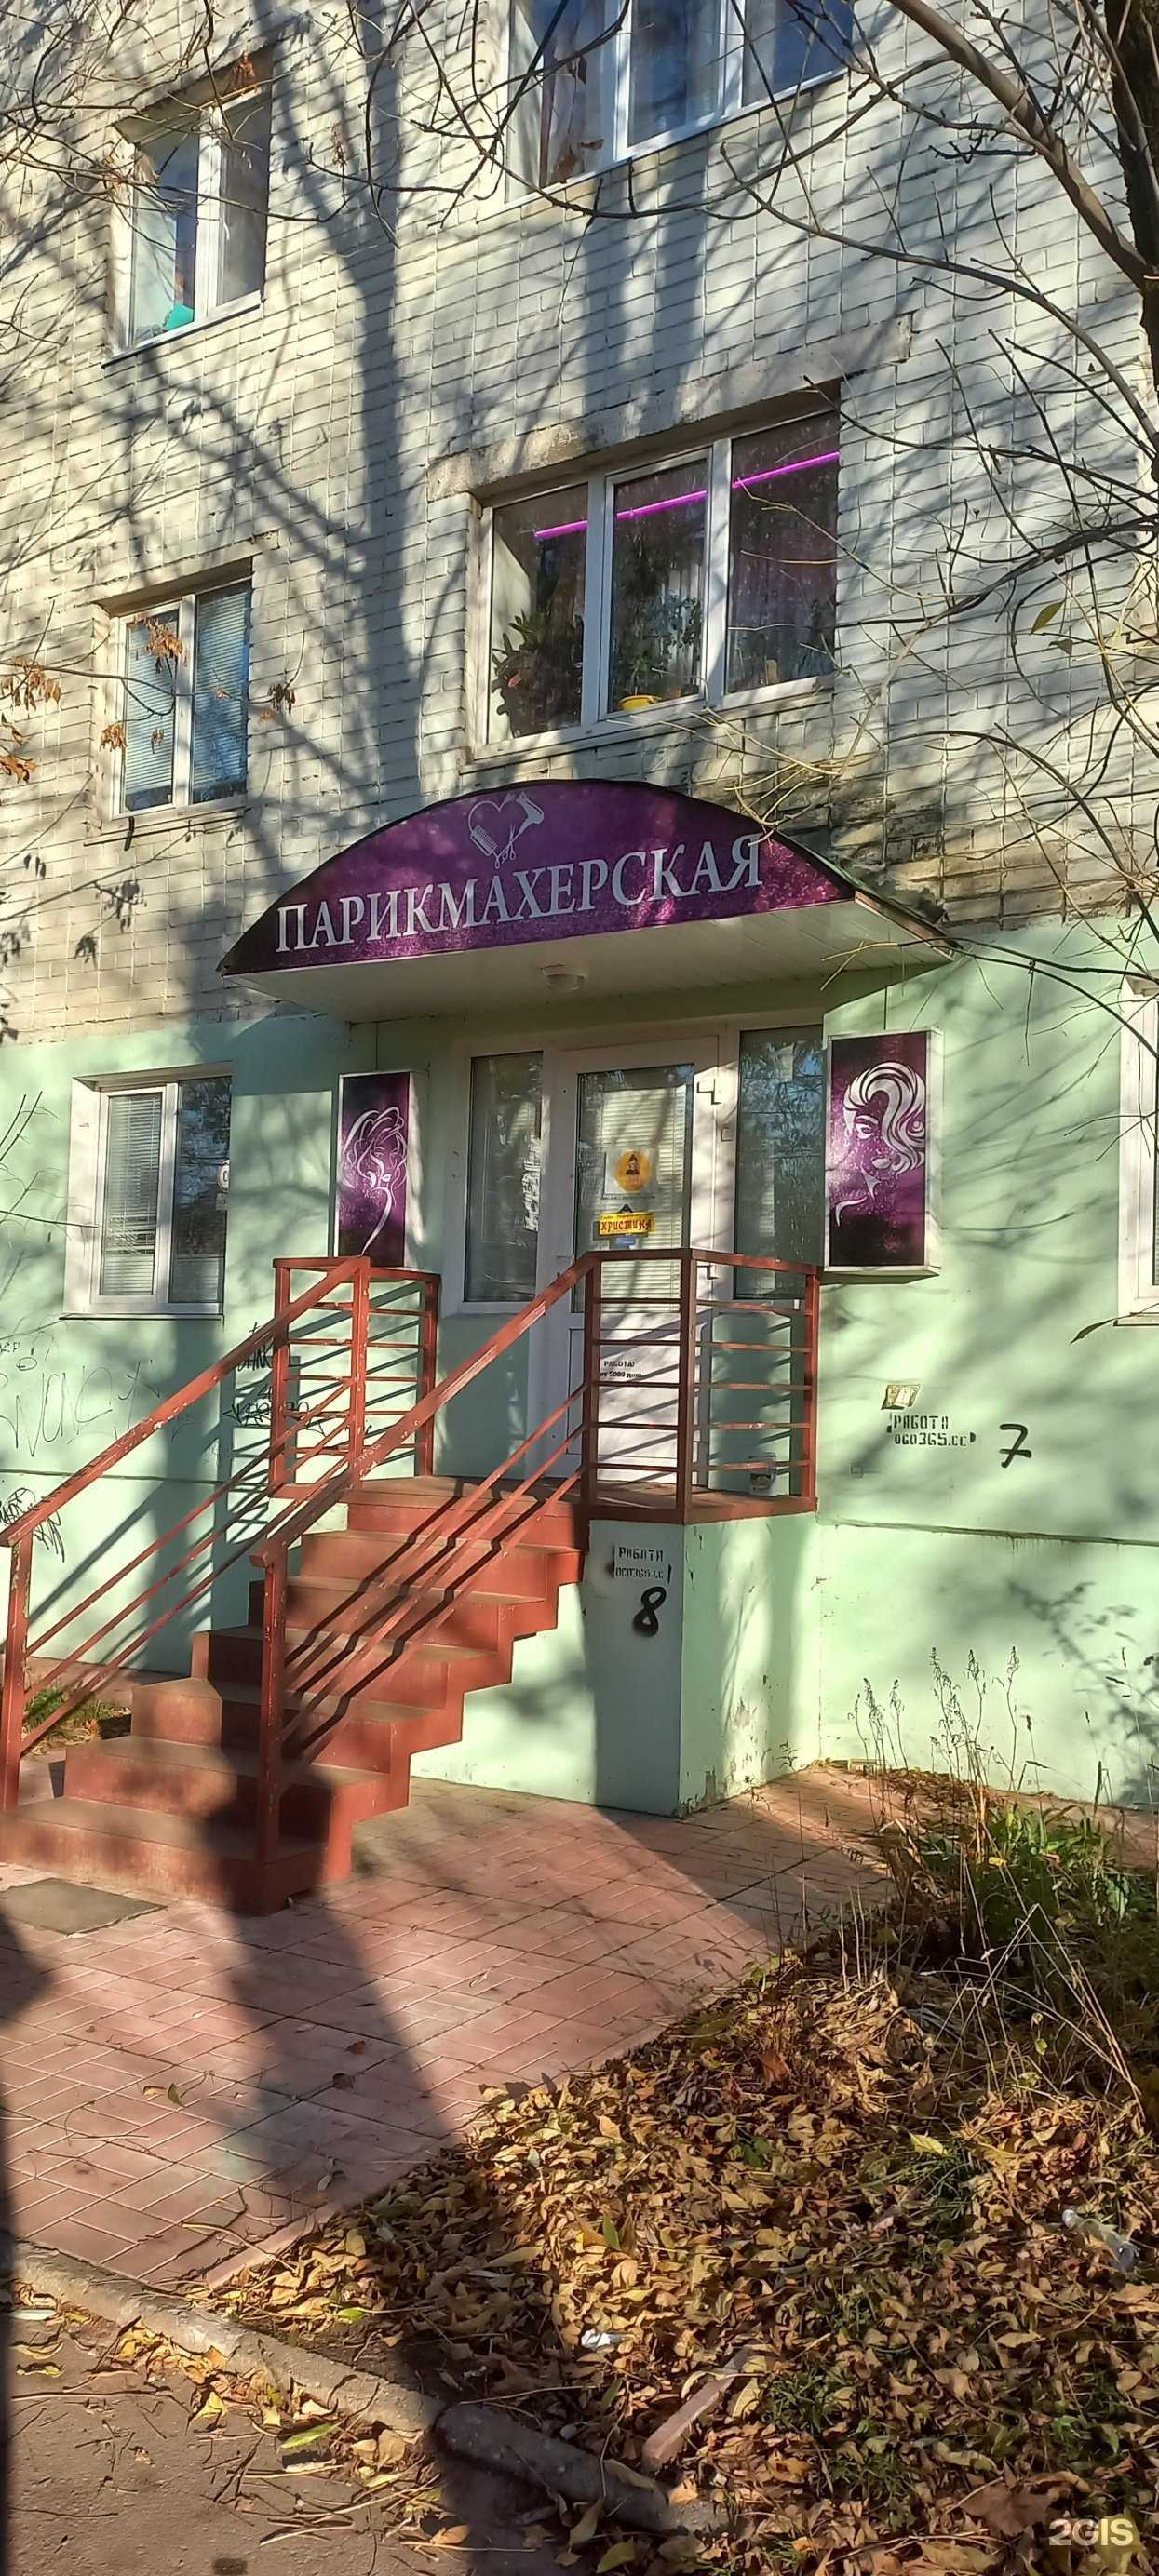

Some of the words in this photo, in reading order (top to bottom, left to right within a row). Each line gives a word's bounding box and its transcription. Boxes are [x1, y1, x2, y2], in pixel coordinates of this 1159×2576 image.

[276, 833, 763, 952] ПАРИКМАХЕРСКАЯ
[999, 1423, 1032, 1469] 7
[633, 1586, 667, 1638] 8
